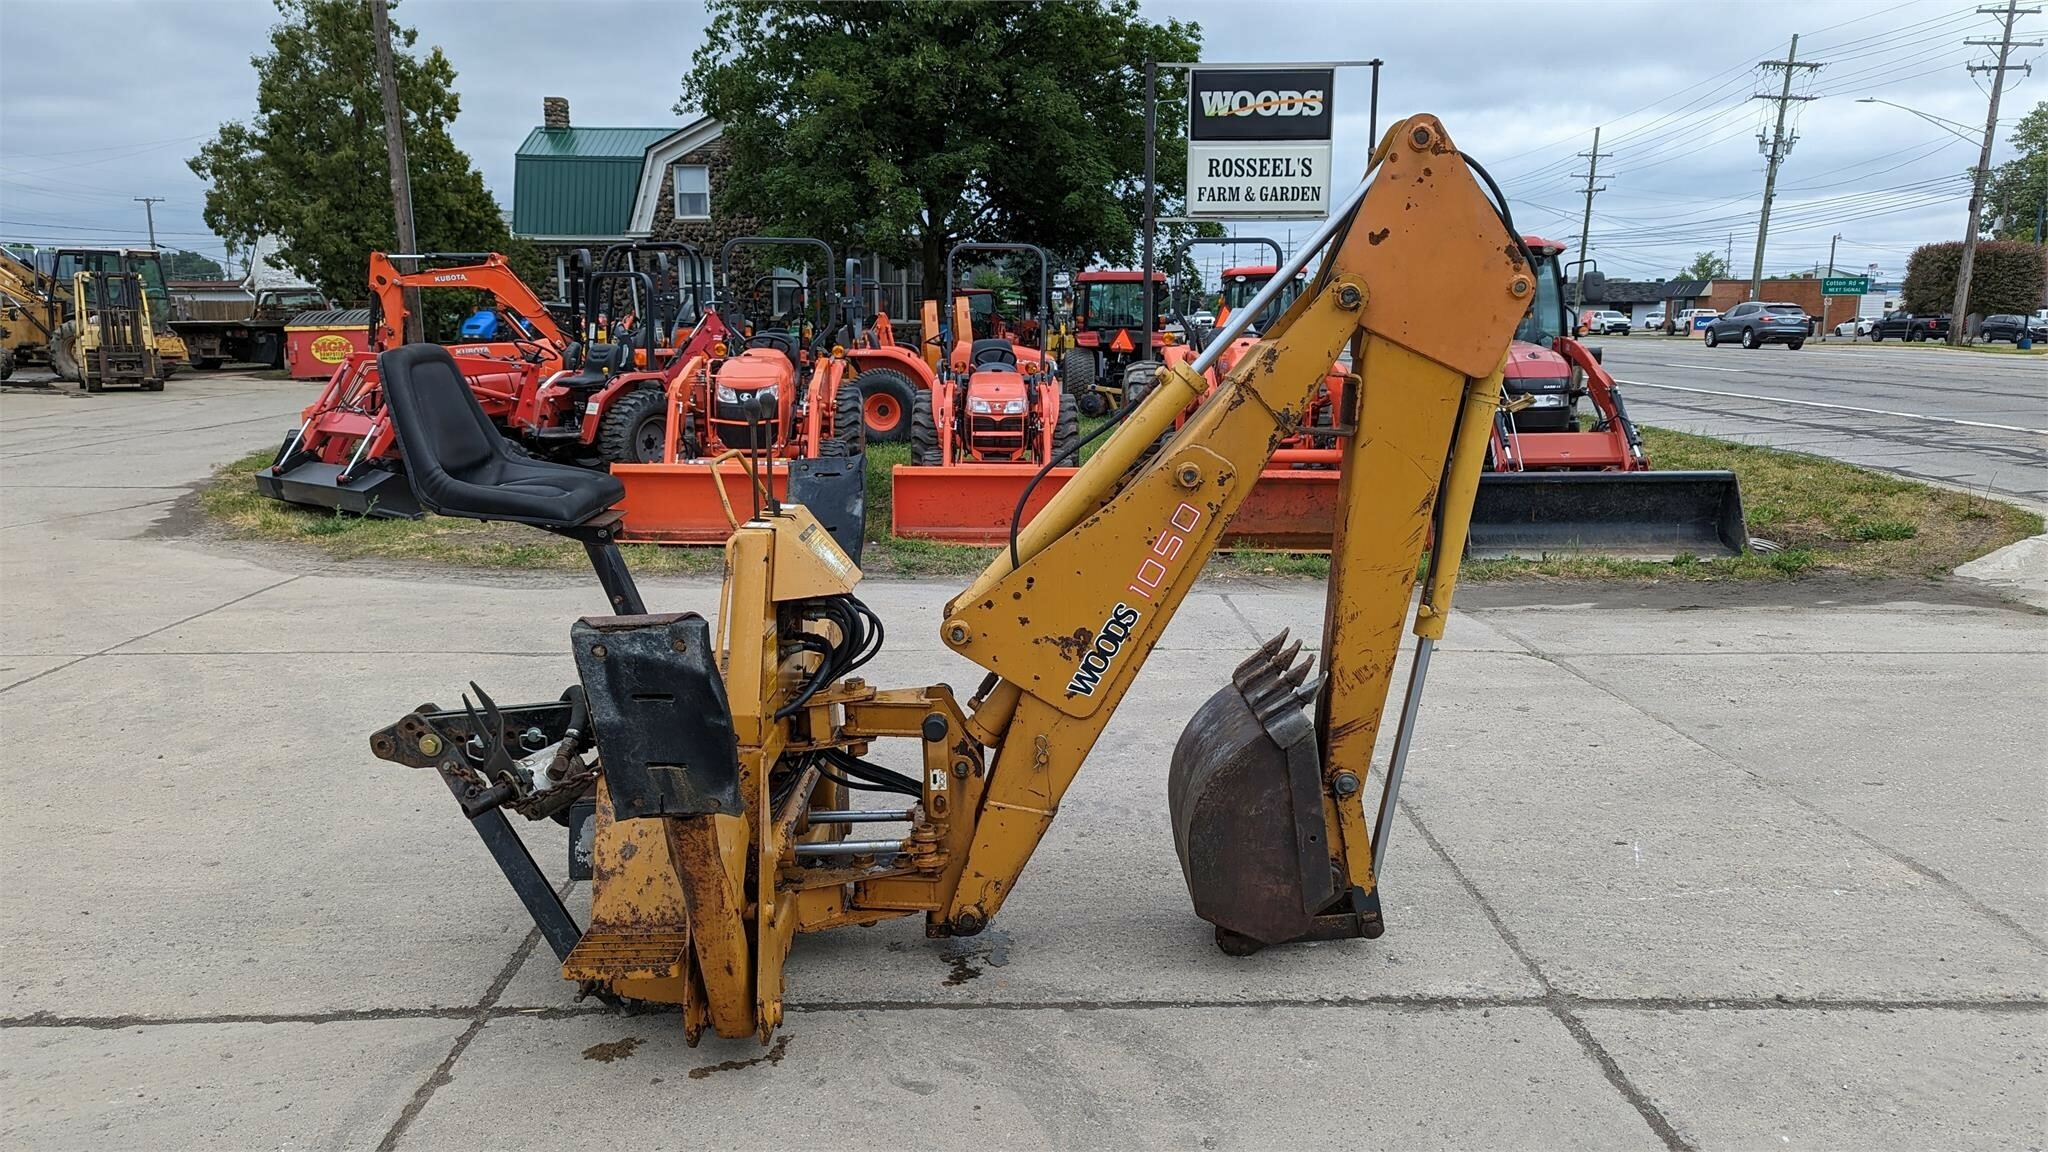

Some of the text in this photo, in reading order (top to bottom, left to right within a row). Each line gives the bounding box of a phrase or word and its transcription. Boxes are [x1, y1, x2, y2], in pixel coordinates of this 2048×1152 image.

[1200, 90, 1323, 117] WOODS
[1208, 157, 1312, 178] ROSSEEL'S
[1197, 186, 1321, 202] FARM & GARDEN
[434, 273, 467, 282] KUBOTA
[315, 340, 351, 352] MGM
[455, 347, 490, 355] KUBOTA
[1127, 502, 1201, 599] 1050
[1066, 602, 1142, 697] WOODS
